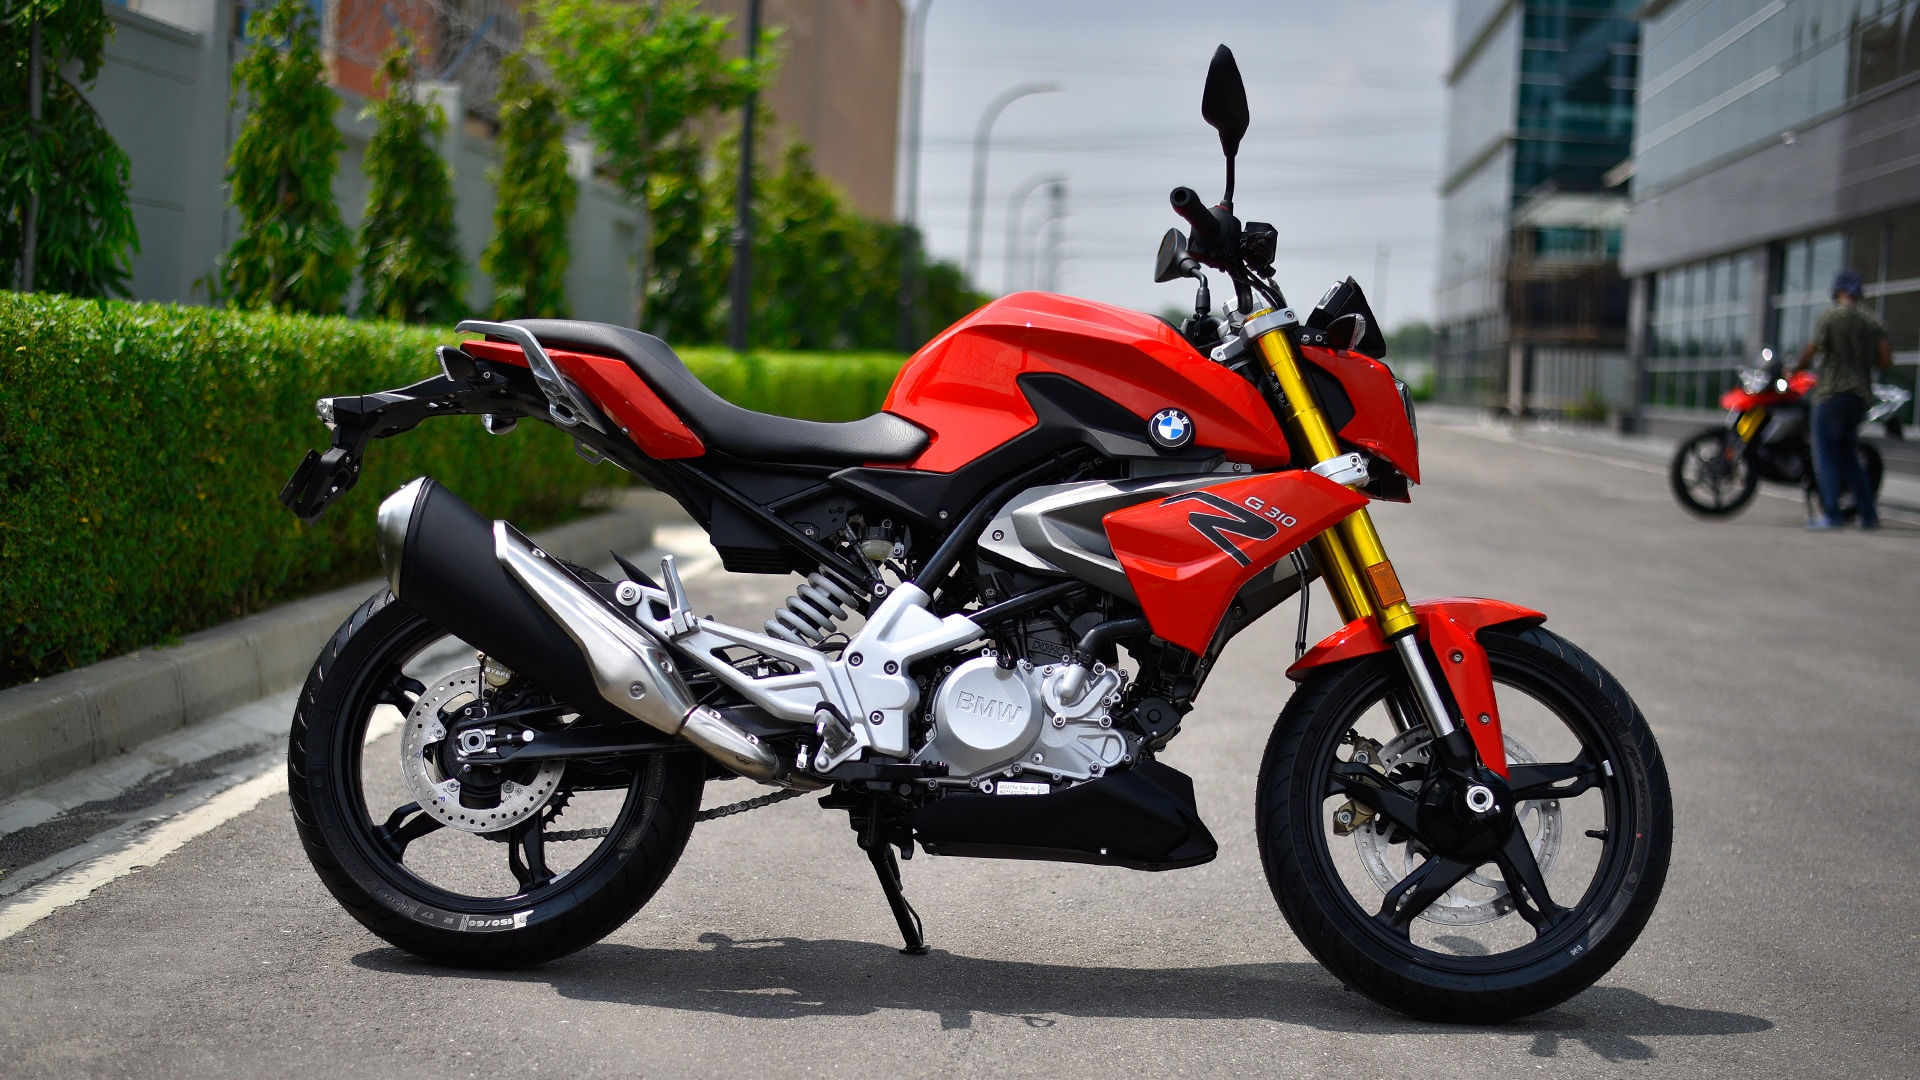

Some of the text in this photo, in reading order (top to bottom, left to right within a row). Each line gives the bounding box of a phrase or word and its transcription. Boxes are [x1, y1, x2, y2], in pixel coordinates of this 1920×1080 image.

[1157, 410, 1189, 426] BMW
[1244, 496, 1297, 528] G 310
[485, 666, 511, 678] BYBRE
[956, 691, 1023, 725] BMW
[468, 917, 514, 927] 150/60
